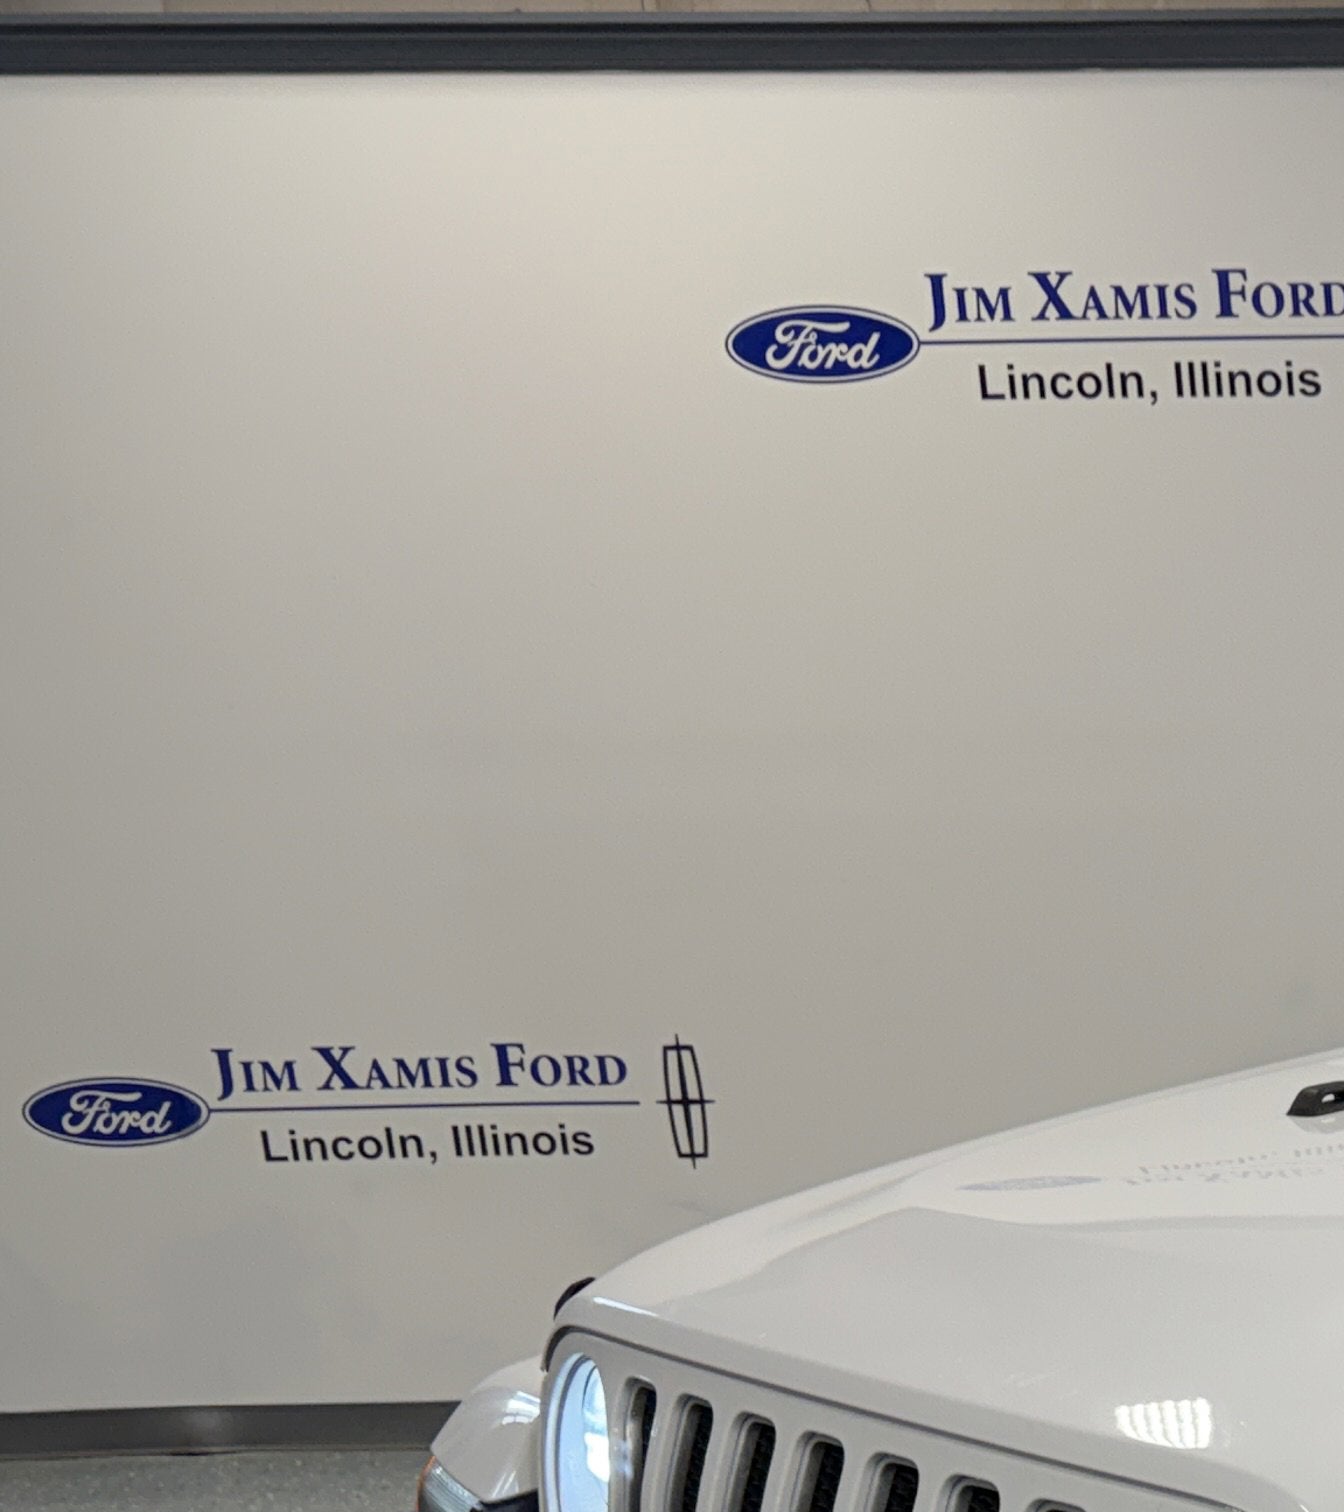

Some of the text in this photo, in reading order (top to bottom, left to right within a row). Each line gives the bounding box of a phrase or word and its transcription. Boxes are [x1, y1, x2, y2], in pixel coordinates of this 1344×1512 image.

[923, 273, 1015, 333] JIM
[1027, 271, 1198, 322] XAMIS
[765, 319, 881, 372] Ford
[978, 360, 1322, 405] Lincoln, Illinois
[210, 1042, 628, 1102] JIM XAMIS FORD
[61, 1089, 172, 1136] Ford
[260, 1123, 595, 1164] Lincoln, Illinois
